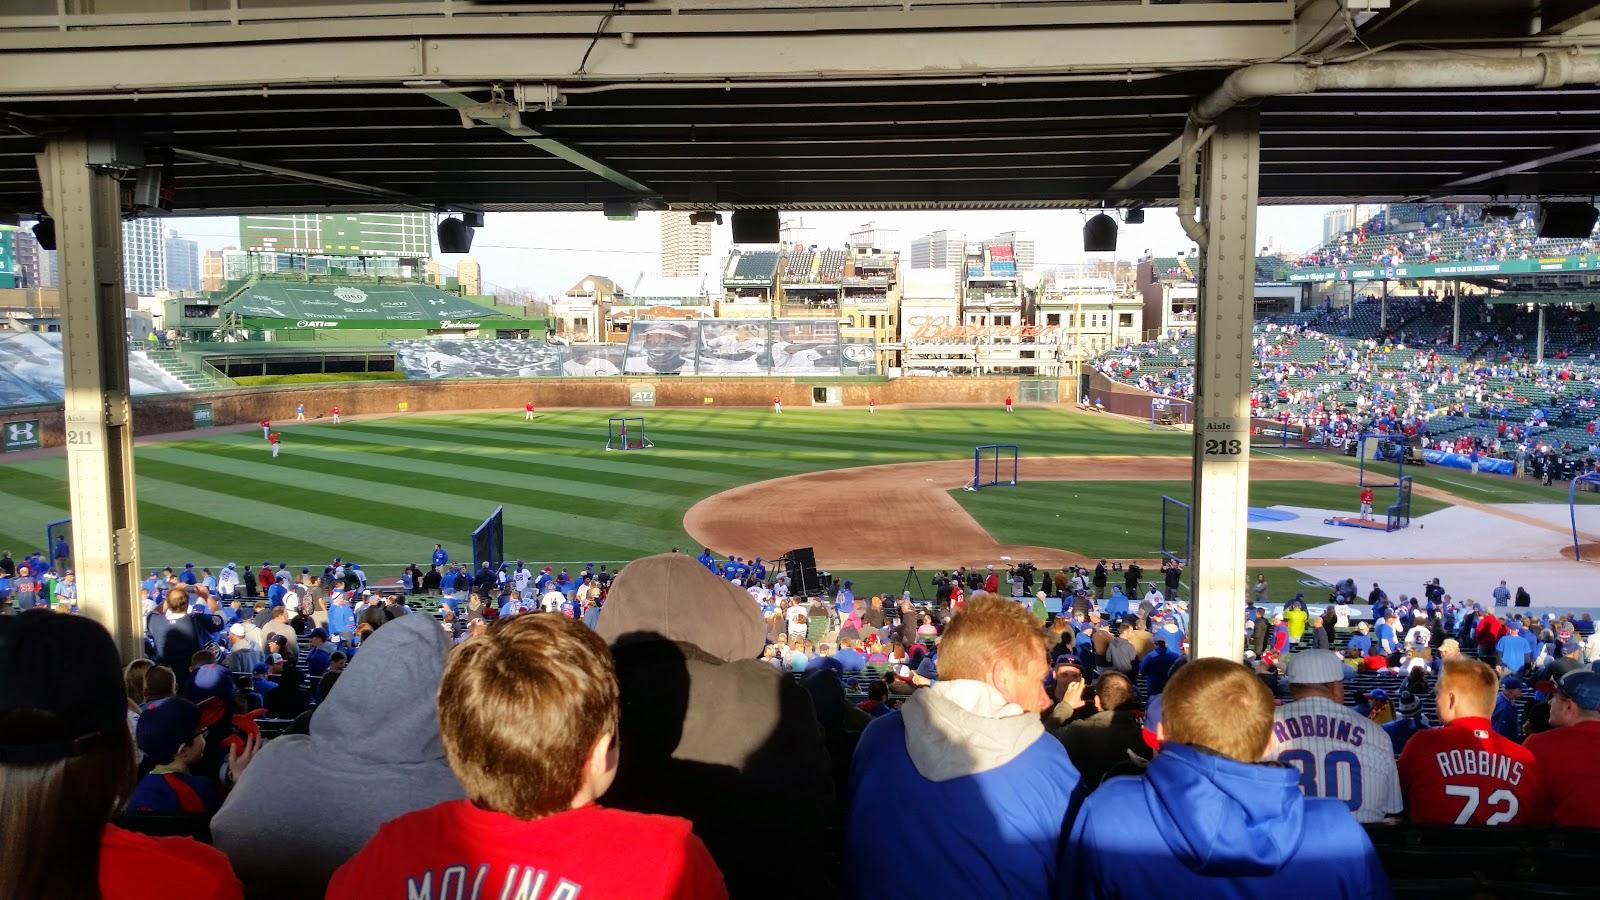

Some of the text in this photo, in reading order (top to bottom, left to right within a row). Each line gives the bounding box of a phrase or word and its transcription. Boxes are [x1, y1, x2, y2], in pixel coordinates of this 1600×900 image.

[850, 349, 867, 358] 14
[632, 391, 654, 399] ATI
[1206, 422, 1231, 430] Aisle
[68, 430, 93, 445] 211
[1205, 439, 1242, 455] 213
[1273, 714, 1366, 747] ROBBINS
[1436, 749, 1524, 786] ROBBINS
[1445, 784, 1519, 826] 72
